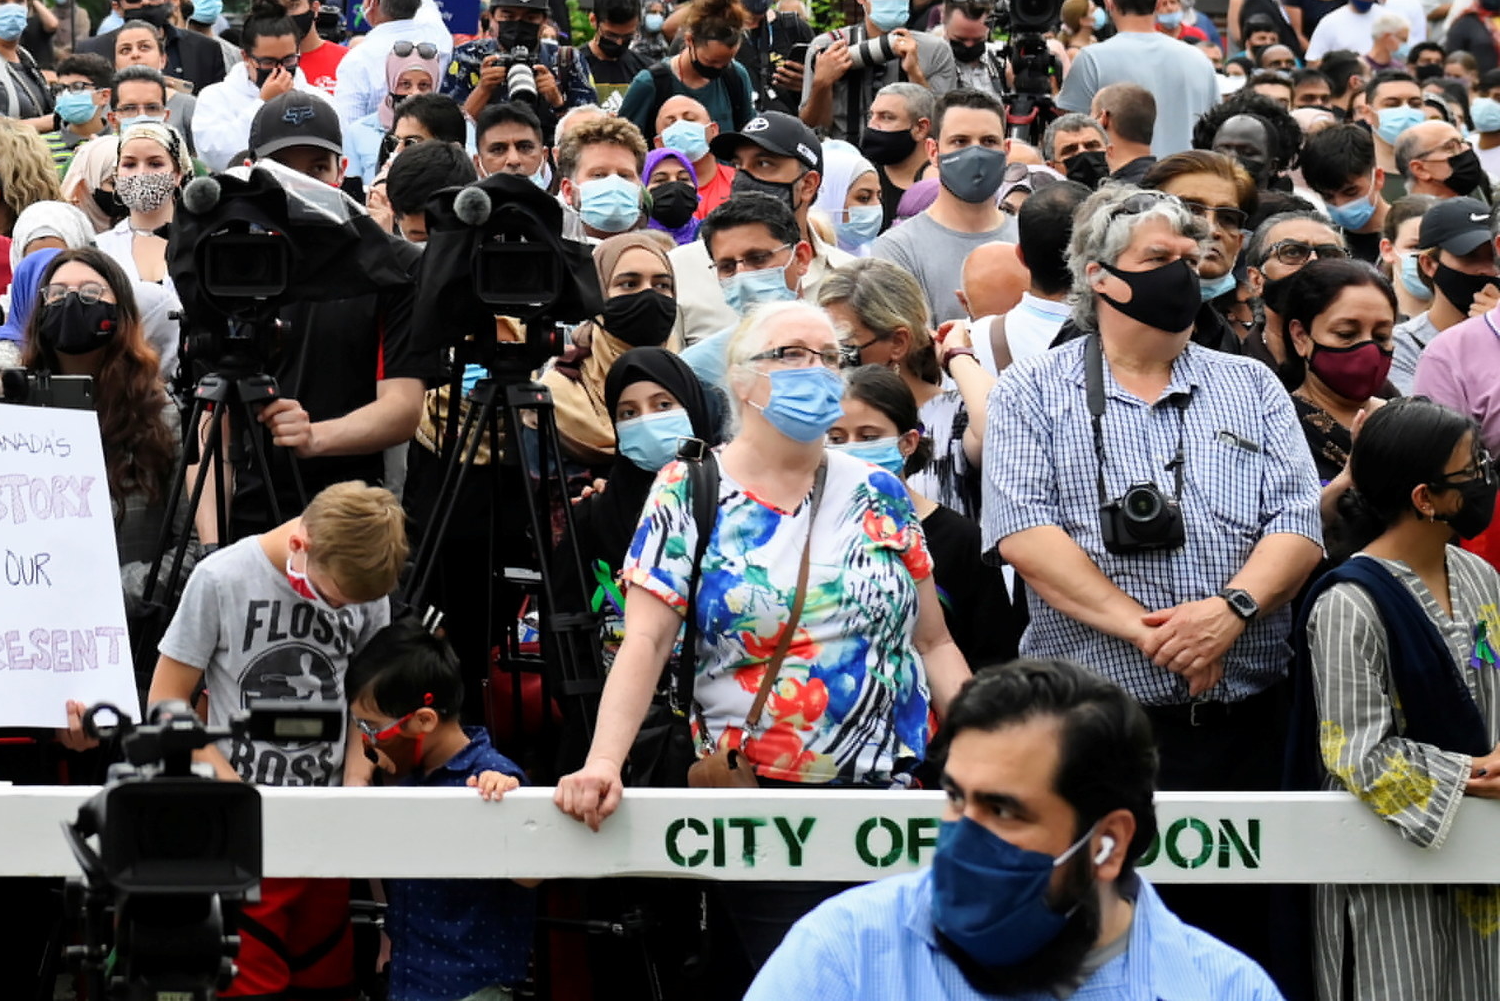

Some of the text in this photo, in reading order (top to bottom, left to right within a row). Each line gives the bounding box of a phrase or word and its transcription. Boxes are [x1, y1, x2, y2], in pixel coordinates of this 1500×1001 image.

[5, 549, 52, 587] OUR
[242, 600, 355, 655] FLOSS
[231, 741, 334, 787] BOSS
[664, 817, 941, 868] CITY OF
